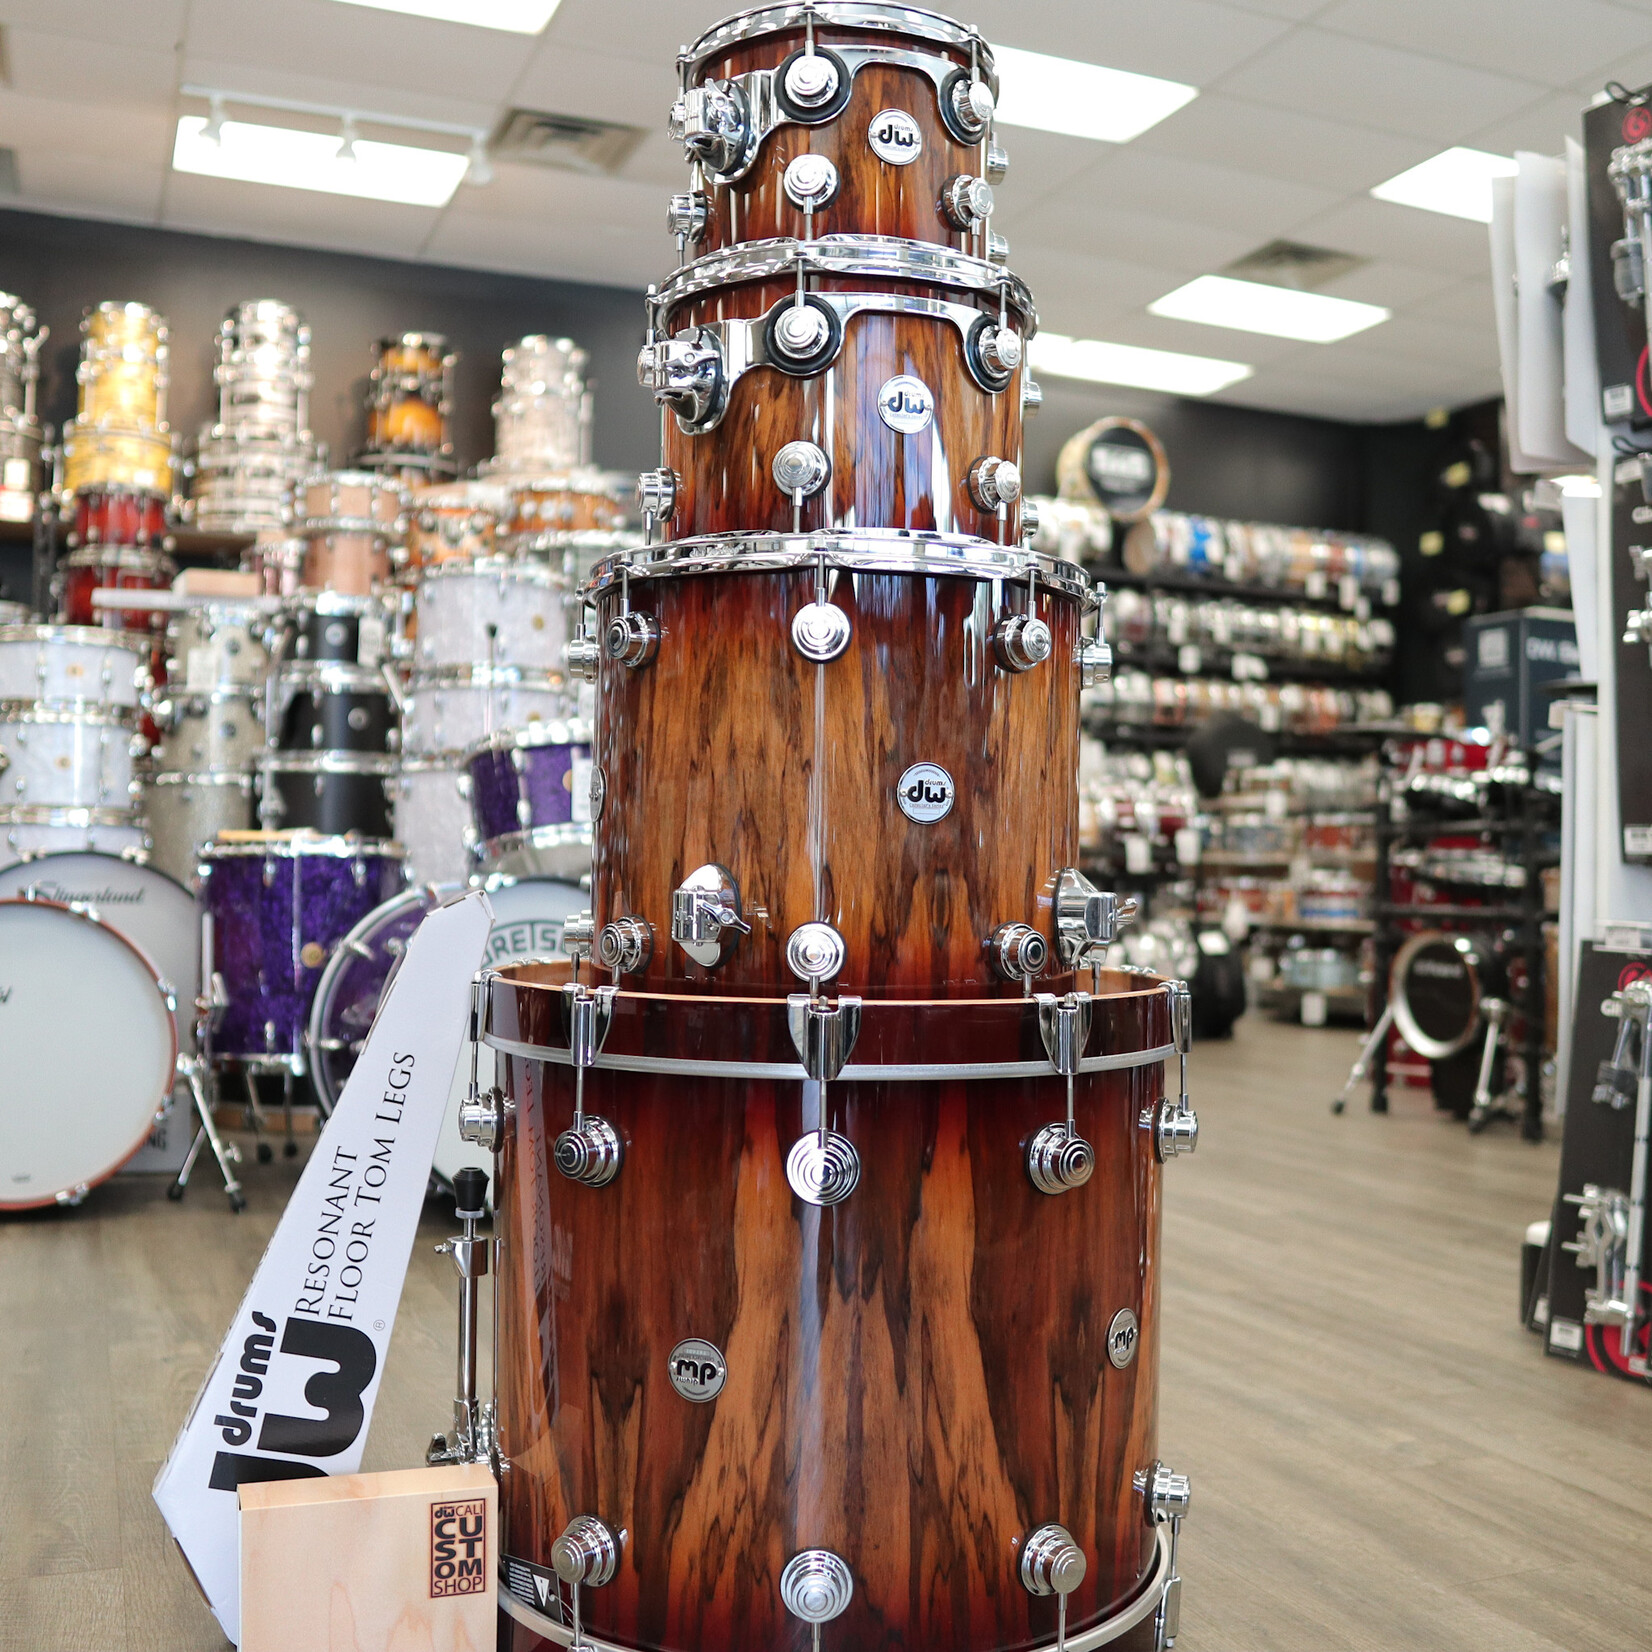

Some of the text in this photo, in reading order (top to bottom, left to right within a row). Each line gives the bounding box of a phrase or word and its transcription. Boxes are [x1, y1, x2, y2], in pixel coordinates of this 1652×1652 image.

[878, 124, 914, 147] dw
[887, 391, 924, 414] dw
[907, 779, 946, 803] dw
[327, 1052, 415, 1321] FLOOR TOM LEGS
[295, 1146, 357, 1315] RESONANT
[214, 1311, 277, 1446] drums
[455, 1503, 483, 1517] CALI
[434, 1576, 483, 1595] SHOP
